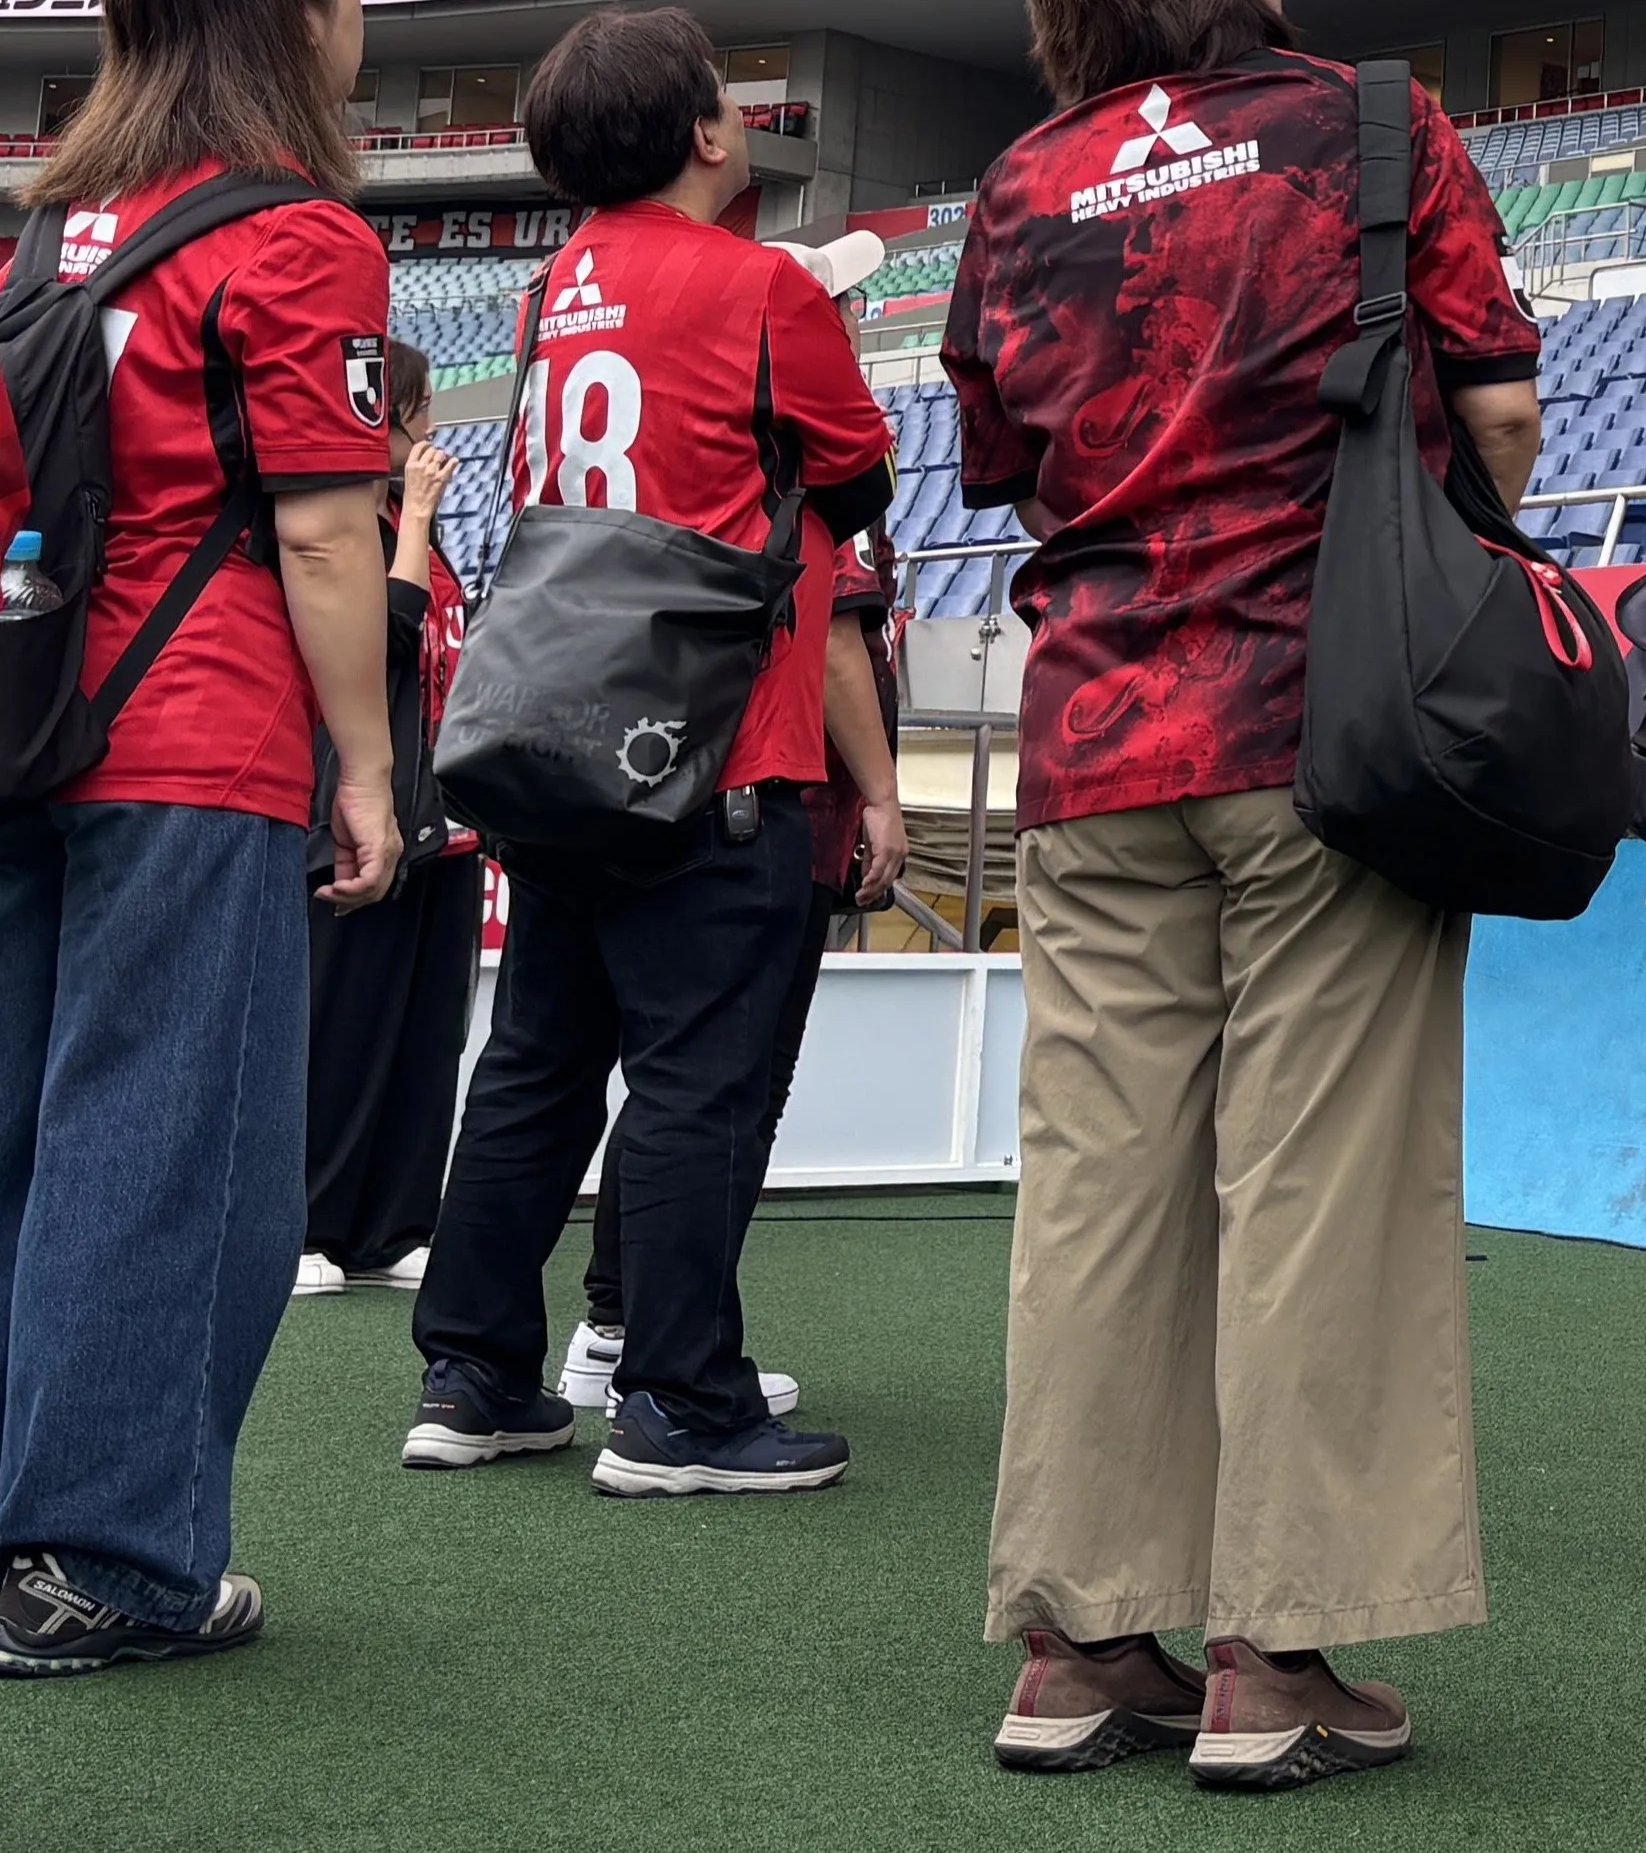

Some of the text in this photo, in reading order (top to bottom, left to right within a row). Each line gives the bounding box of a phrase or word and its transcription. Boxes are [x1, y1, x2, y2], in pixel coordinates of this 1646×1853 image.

[1071, 140, 1259, 211] MITSUBISHI
[1072, 159, 1260, 224] HEAVY INDUSTRIES
[438, 211, 492, 249] ES
[33, 1580, 96, 1612] SALOMON
